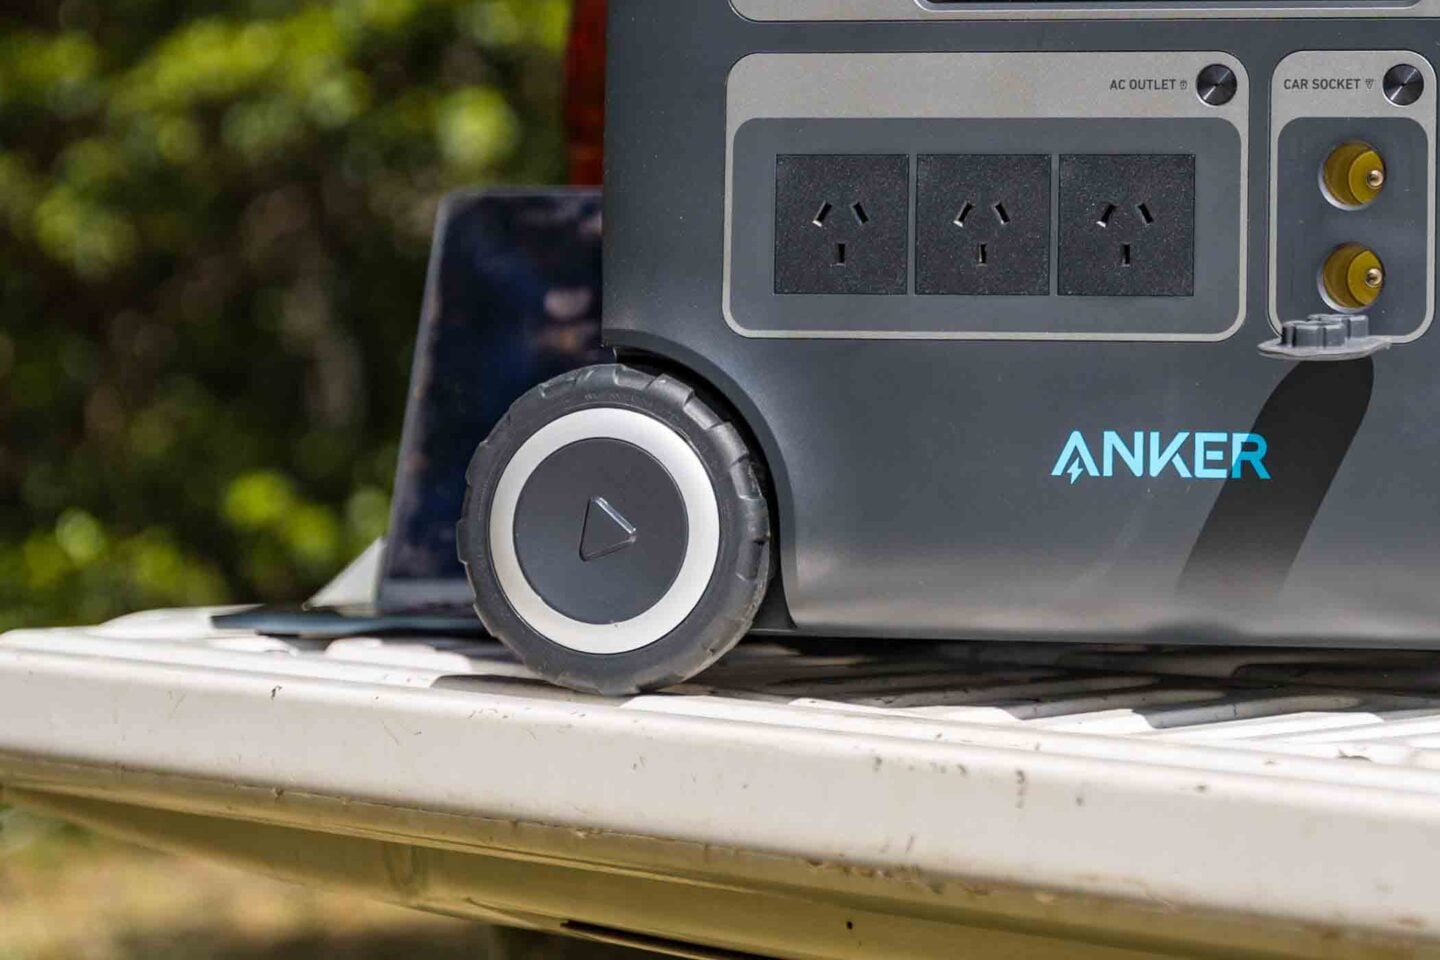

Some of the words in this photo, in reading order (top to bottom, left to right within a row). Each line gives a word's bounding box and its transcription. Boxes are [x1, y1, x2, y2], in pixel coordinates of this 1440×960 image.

[1109, 78, 1126, 90] AC
[1128, 78, 1177, 90] OUTLET
[1283, 78, 1309, 90] CAR
[1311, 78, 1361, 90] SOCKET
[1051, 430, 1271, 482] ANKER
